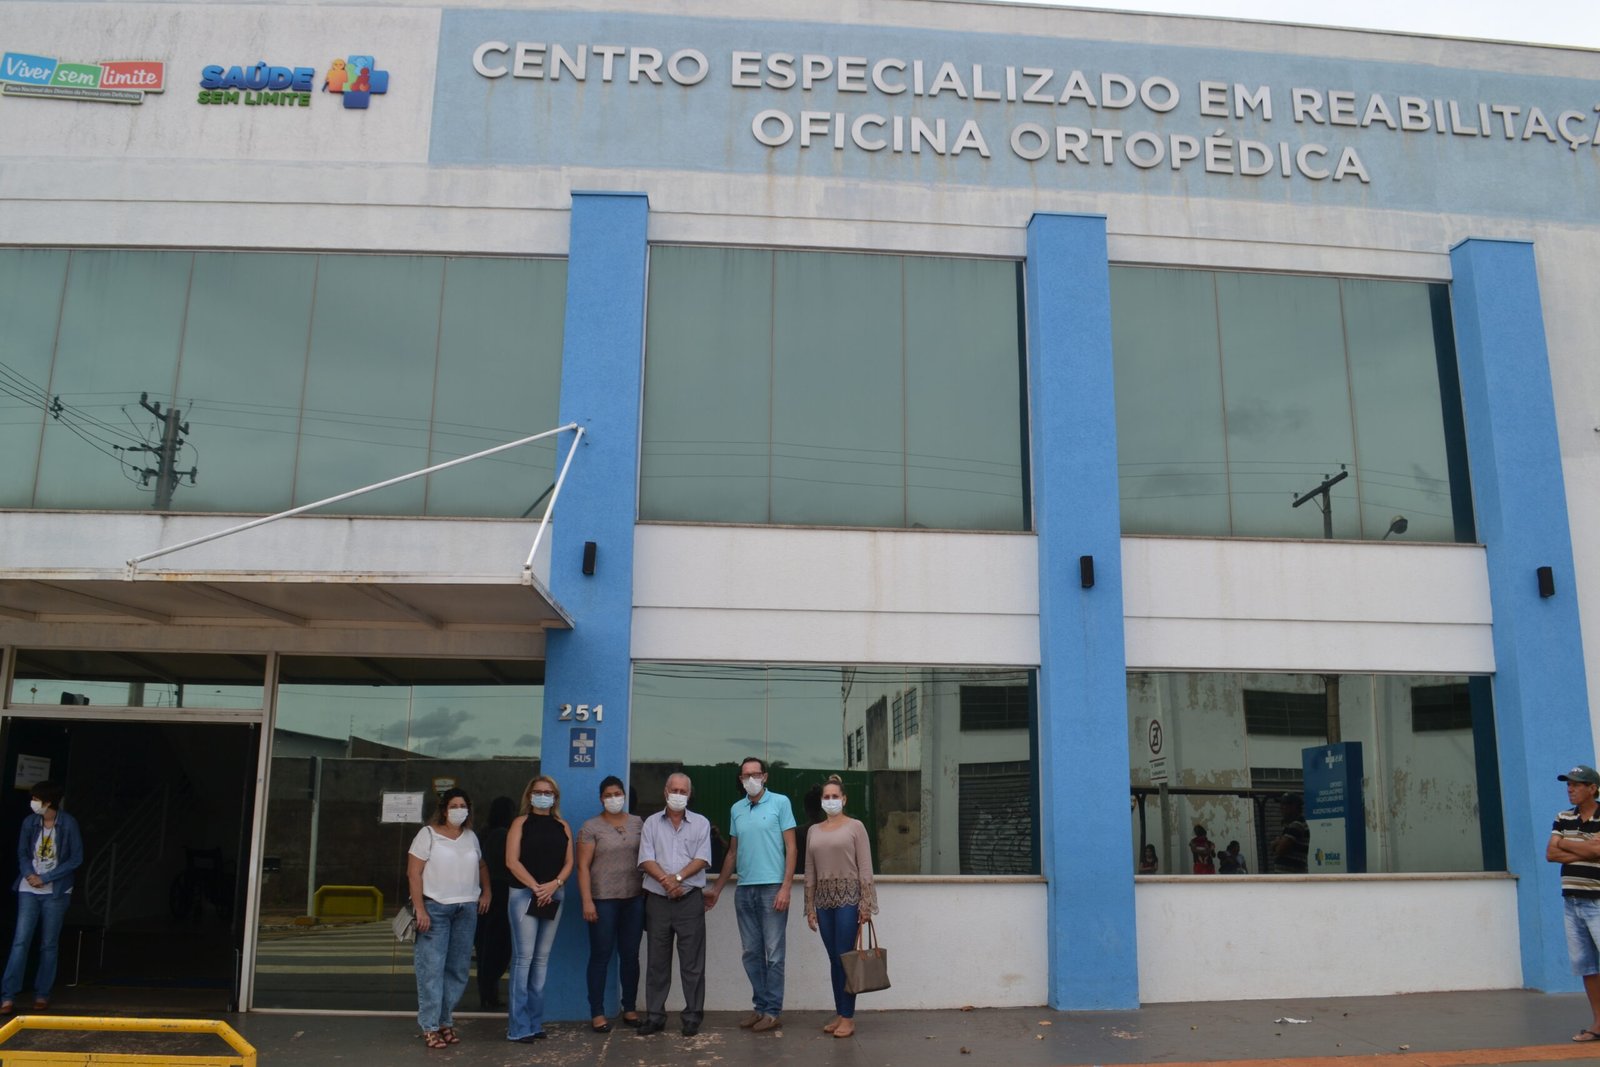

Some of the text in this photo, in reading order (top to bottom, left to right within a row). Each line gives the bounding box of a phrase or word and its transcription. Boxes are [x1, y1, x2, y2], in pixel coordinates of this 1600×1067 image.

[7, 57, 158, 86] Viver sem limite
[199, 59, 316, 92] SAÚDE
[197, 90, 312, 107] SEM LIMITE
[472, 40, 1600, 151] CENTRO ESPECIALIZADO EM REABILITAÇ
[751, 109, 1370, 184] OFICINA ORTOPÉDICA
[558, 704, 603, 721] 251
[573, 754, 591, 763] SUS
